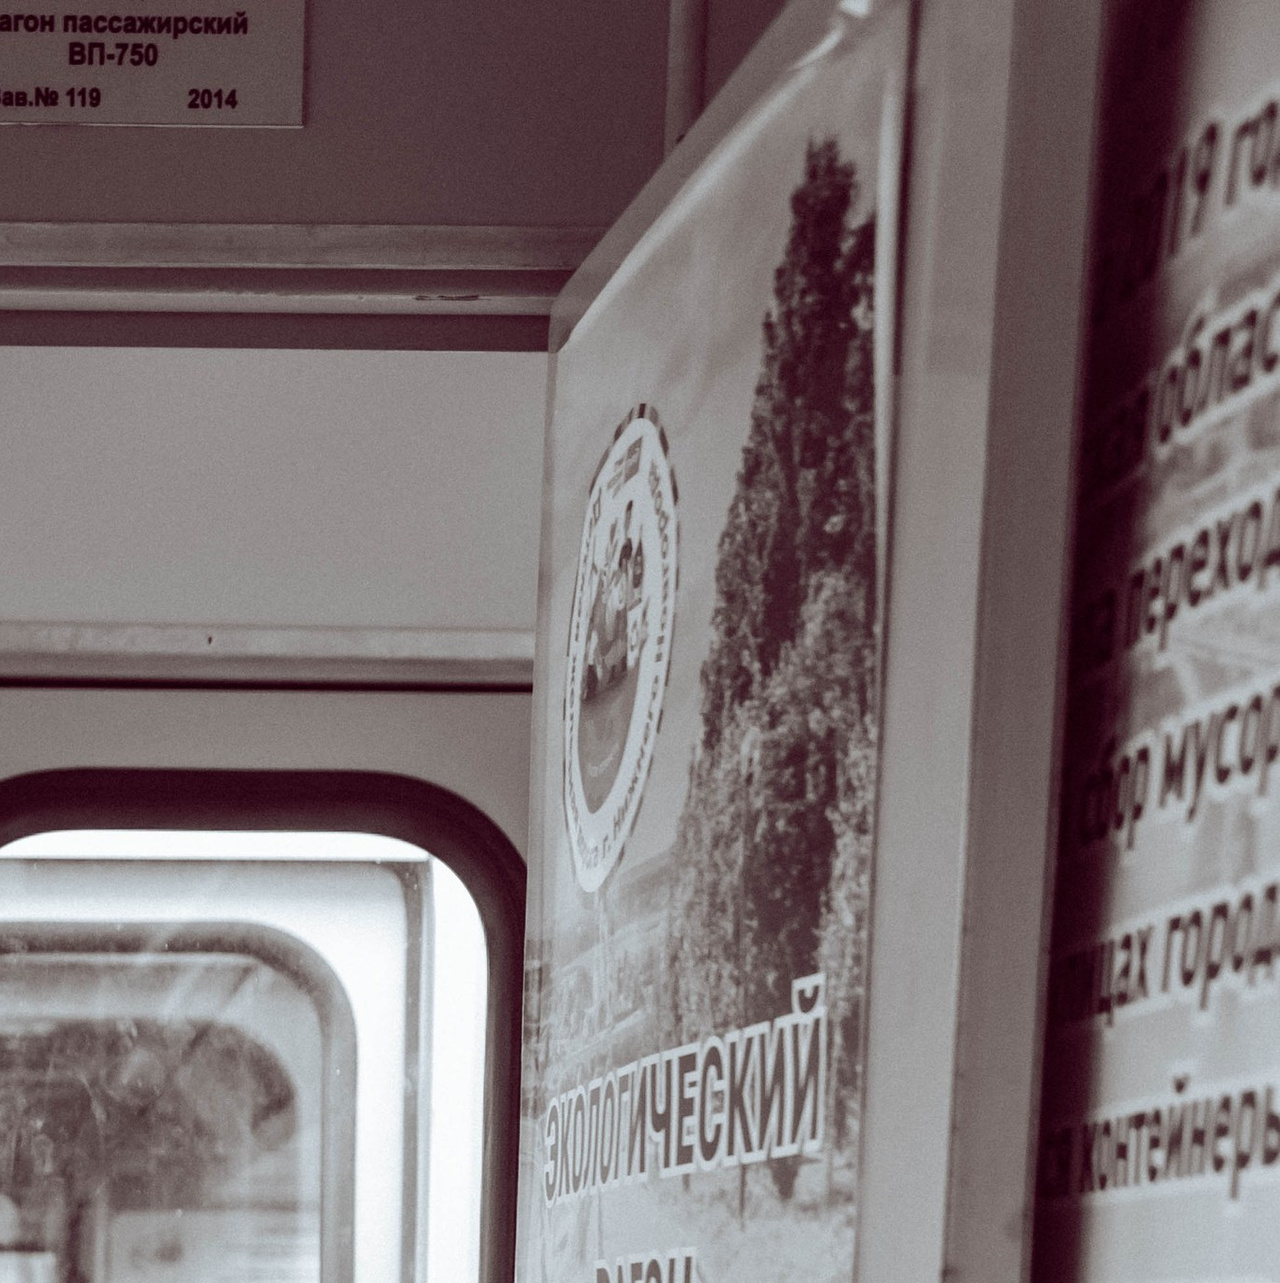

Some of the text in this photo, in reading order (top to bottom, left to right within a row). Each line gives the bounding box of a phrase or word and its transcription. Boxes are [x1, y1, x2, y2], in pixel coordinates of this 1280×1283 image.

[62, 12, 249, 37] пассажирский
[67, 42, 159, 67] ВП-750
[65, 87, 102, 108] 119
[186, 88, 239, 110] 2014
[1225, 100, 1280, 205] го
[546, 983, 822, 1201] ЭКОЛОГИЧЕСКИЙ
